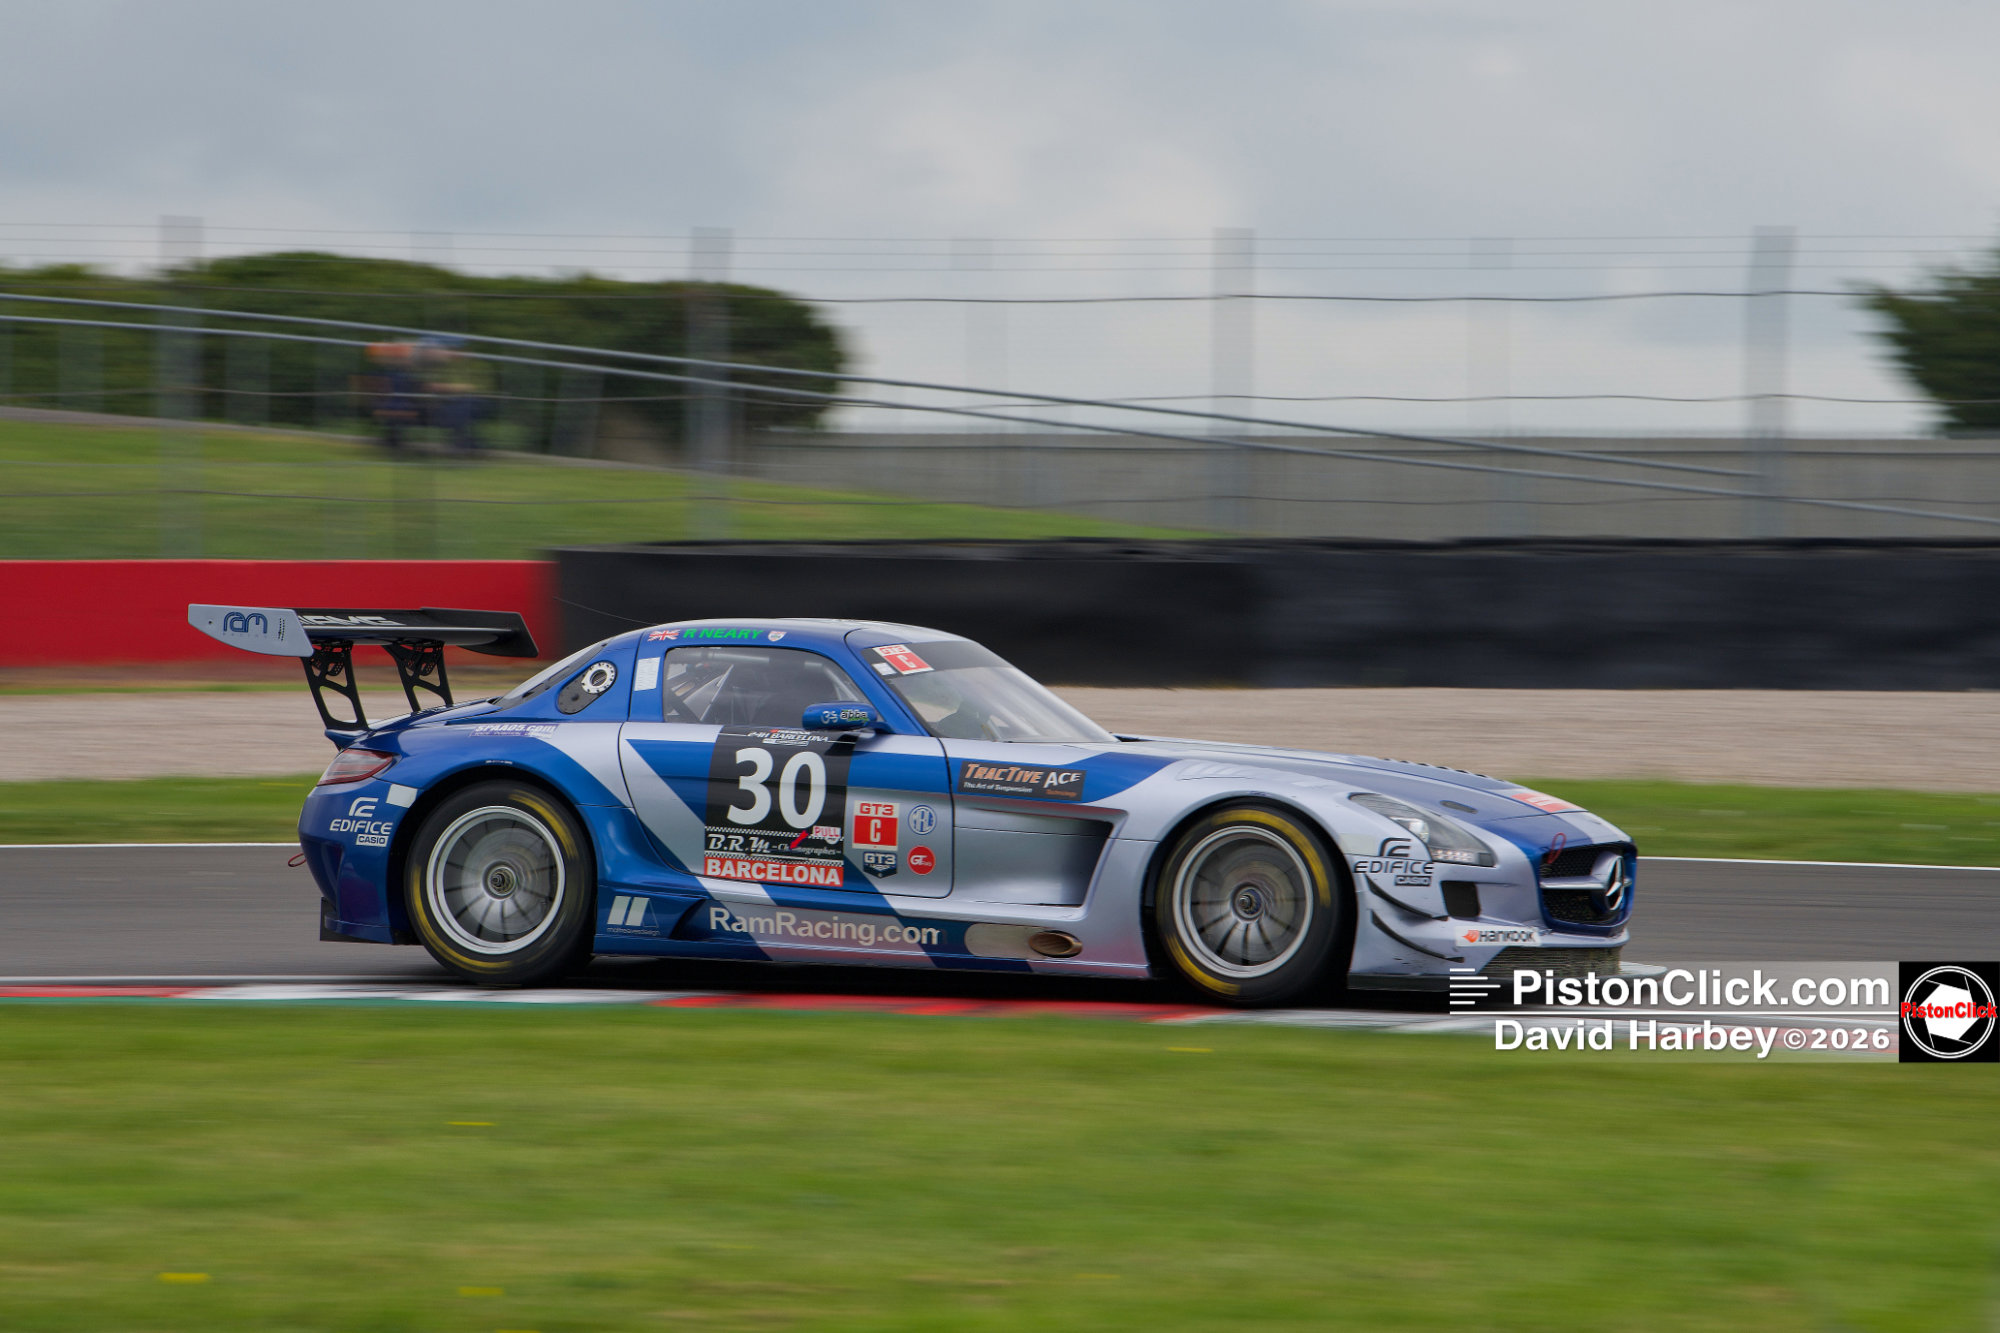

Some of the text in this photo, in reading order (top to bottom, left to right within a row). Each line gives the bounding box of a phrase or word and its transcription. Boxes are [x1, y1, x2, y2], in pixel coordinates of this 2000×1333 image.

[683, 628, 763, 639] R NEARY
[896, 654, 917, 668] C
[726, 747, 827, 829] 30
[859, 802, 894, 816] GT3
[329, 819, 394, 835] EDIFICE
[814, 826, 839, 837] PULL
[870, 818, 882, 843] C
[358, 836, 386, 844] CASIO
[864, 853, 896, 865] GT3
[707, 858, 841, 885] BARCELONA
[1354, 860, 1434, 875] EDIFICE
[1396, 877, 1430, 886] CASIO
